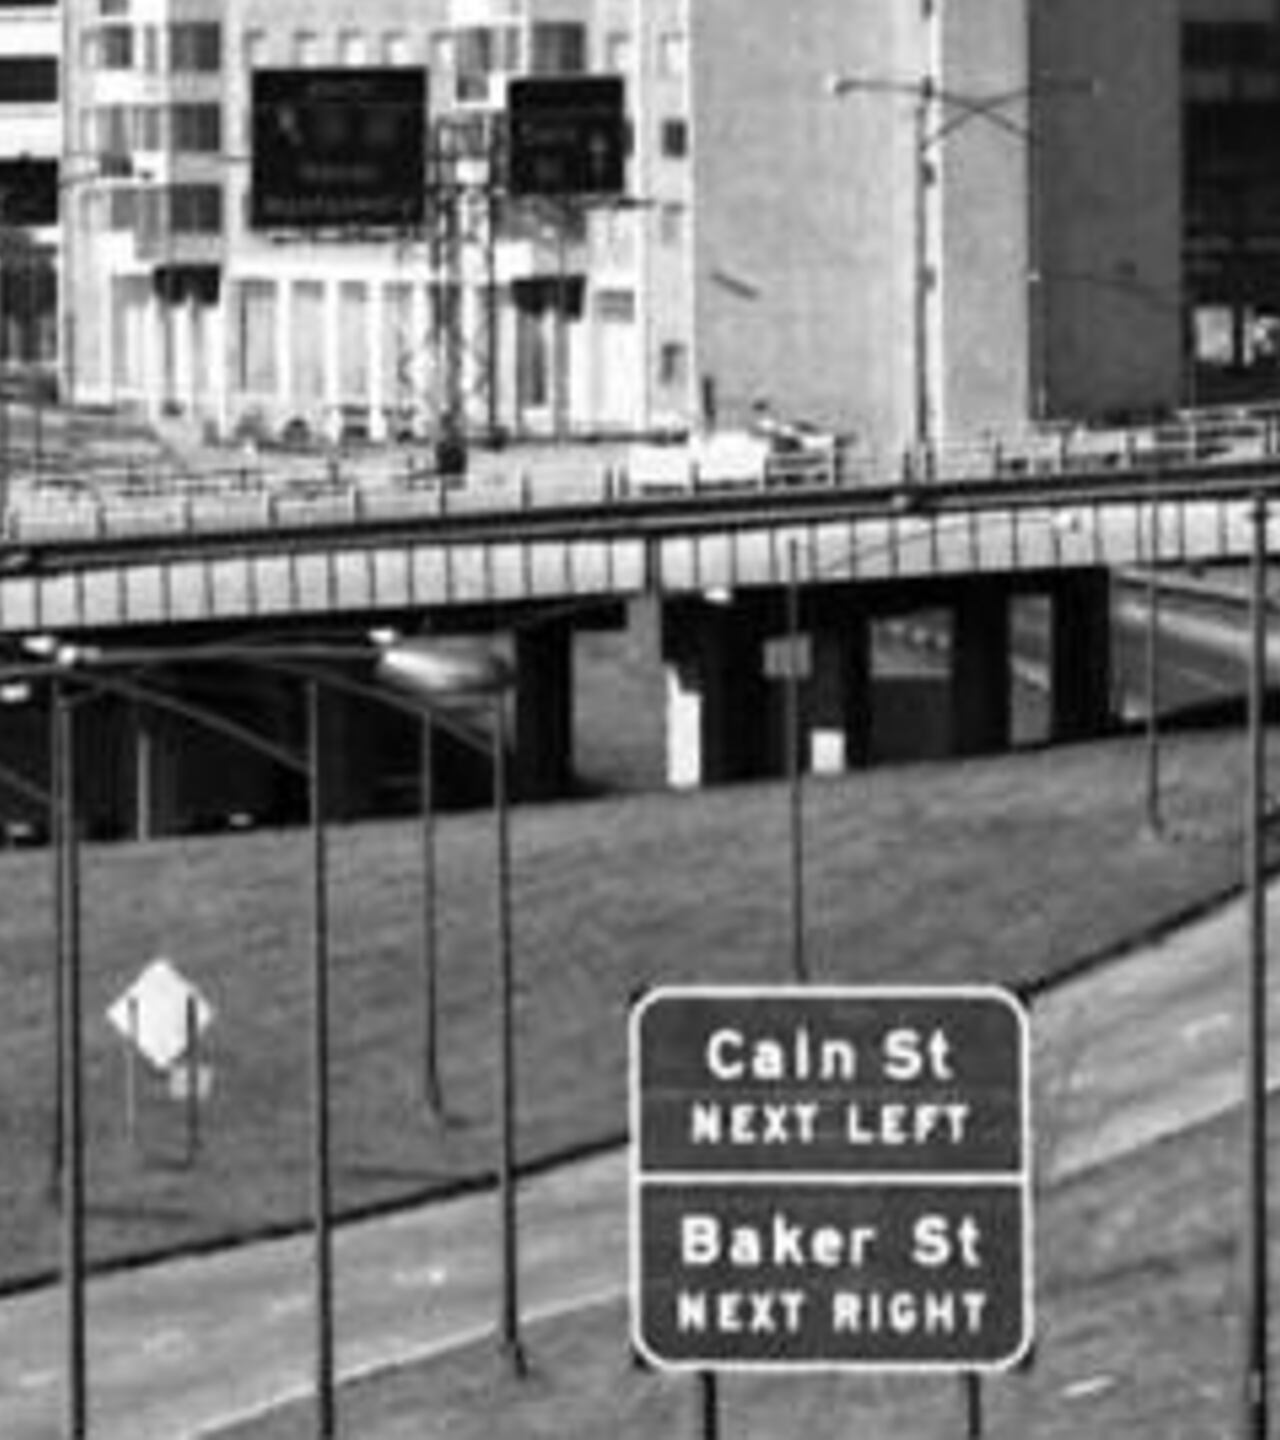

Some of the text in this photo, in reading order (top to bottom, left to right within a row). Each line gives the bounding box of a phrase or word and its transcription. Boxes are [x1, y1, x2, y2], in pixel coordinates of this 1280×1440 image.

[704, 1025, 953, 1081] Cain St
[690, 1101, 970, 1145] NEXT LEFT
[679, 1211, 980, 1267] Baker St
[675, 1290, 987, 1333] NEXT RIGHT
